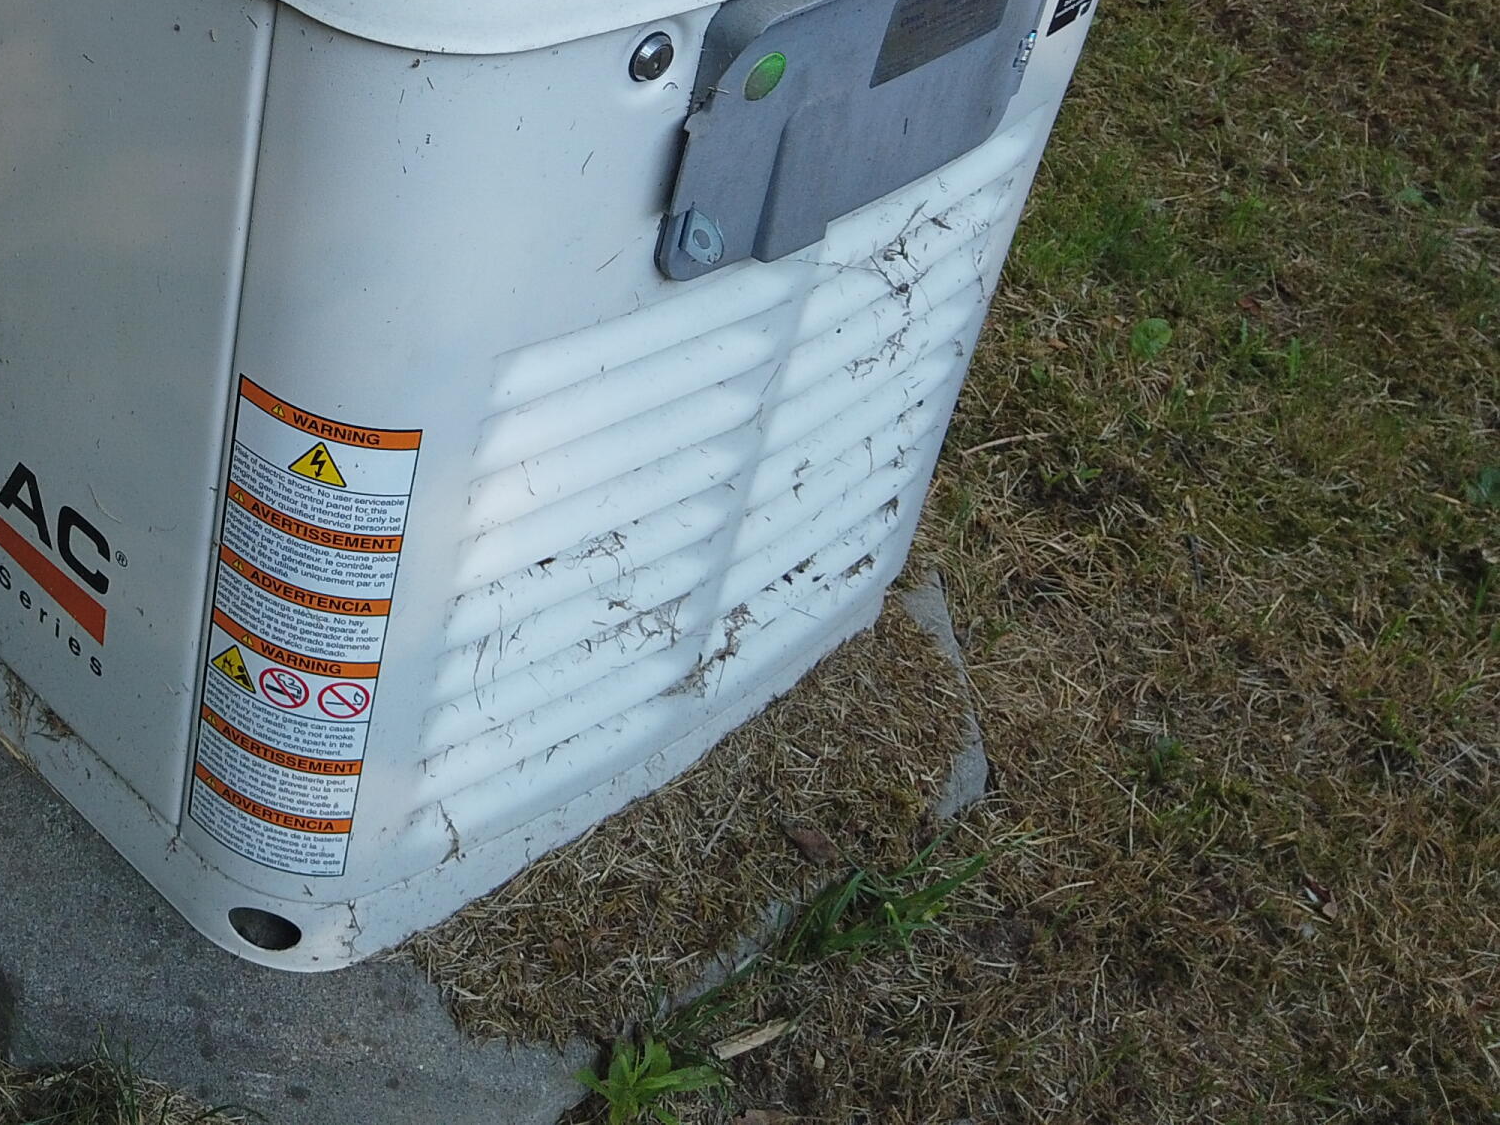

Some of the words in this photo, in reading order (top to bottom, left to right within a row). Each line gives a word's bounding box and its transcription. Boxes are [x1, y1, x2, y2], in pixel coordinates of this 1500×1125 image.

[293, 412, 380, 445] WARNING
[233, 463, 257, 485] engine
[258, 481, 298, 506] generator
[301, 501, 308, 510] is
[311, 504, 352, 521] intended
[354, 514, 364, 522] to
[366, 516, 387, 525] only
[252, 466, 274, 486] inside.
[278, 481, 293, 494] The
[294, 490, 324, 505] control
[326, 501, 353, 512] panel
[355, 505, 368, 514] for
[370, 507, 387, 515] this
[259, 463, 286, 482] electric
[287, 478, 314, 494] shock.
[317, 488, 331, 498] No
[333, 494, 352, 503] user
[354, 498, 405, 506] serviceable
[251, 502, 396, 550] AVERTISSEMENT
[266, 493, 276, 507] by
[277, 501, 316, 521] qualified
[317, 517, 351, 529] service
[253, 518, 263, 530] de
[264, 527, 284, 541] choc
[334, 551, 370, 562] Aucune
[371, 555, 396, 564] pièce
[258, 539, 267, 551] de
[269, 548, 279, 557] ce
[281, 554, 329, 574] générateur
[331, 567, 343, 576] de
[345, 571, 377, 579] moteur
[380, 571, 394, 579] est
[261, 534, 274, 546] par
[325, 558, 334, 566] le
[335, 562, 373, 571] contrôle
[250, 570, 372, 613] ADVERTENCIA
[300, 570, 355, 586] uniquement
[356, 581, 371, 589] par
[260, 641, 341, 674] WARNING
[222, 726, 357, 773] AVERTISSEMENT
[221, 788, 334, 831] ADVERTENCIA
